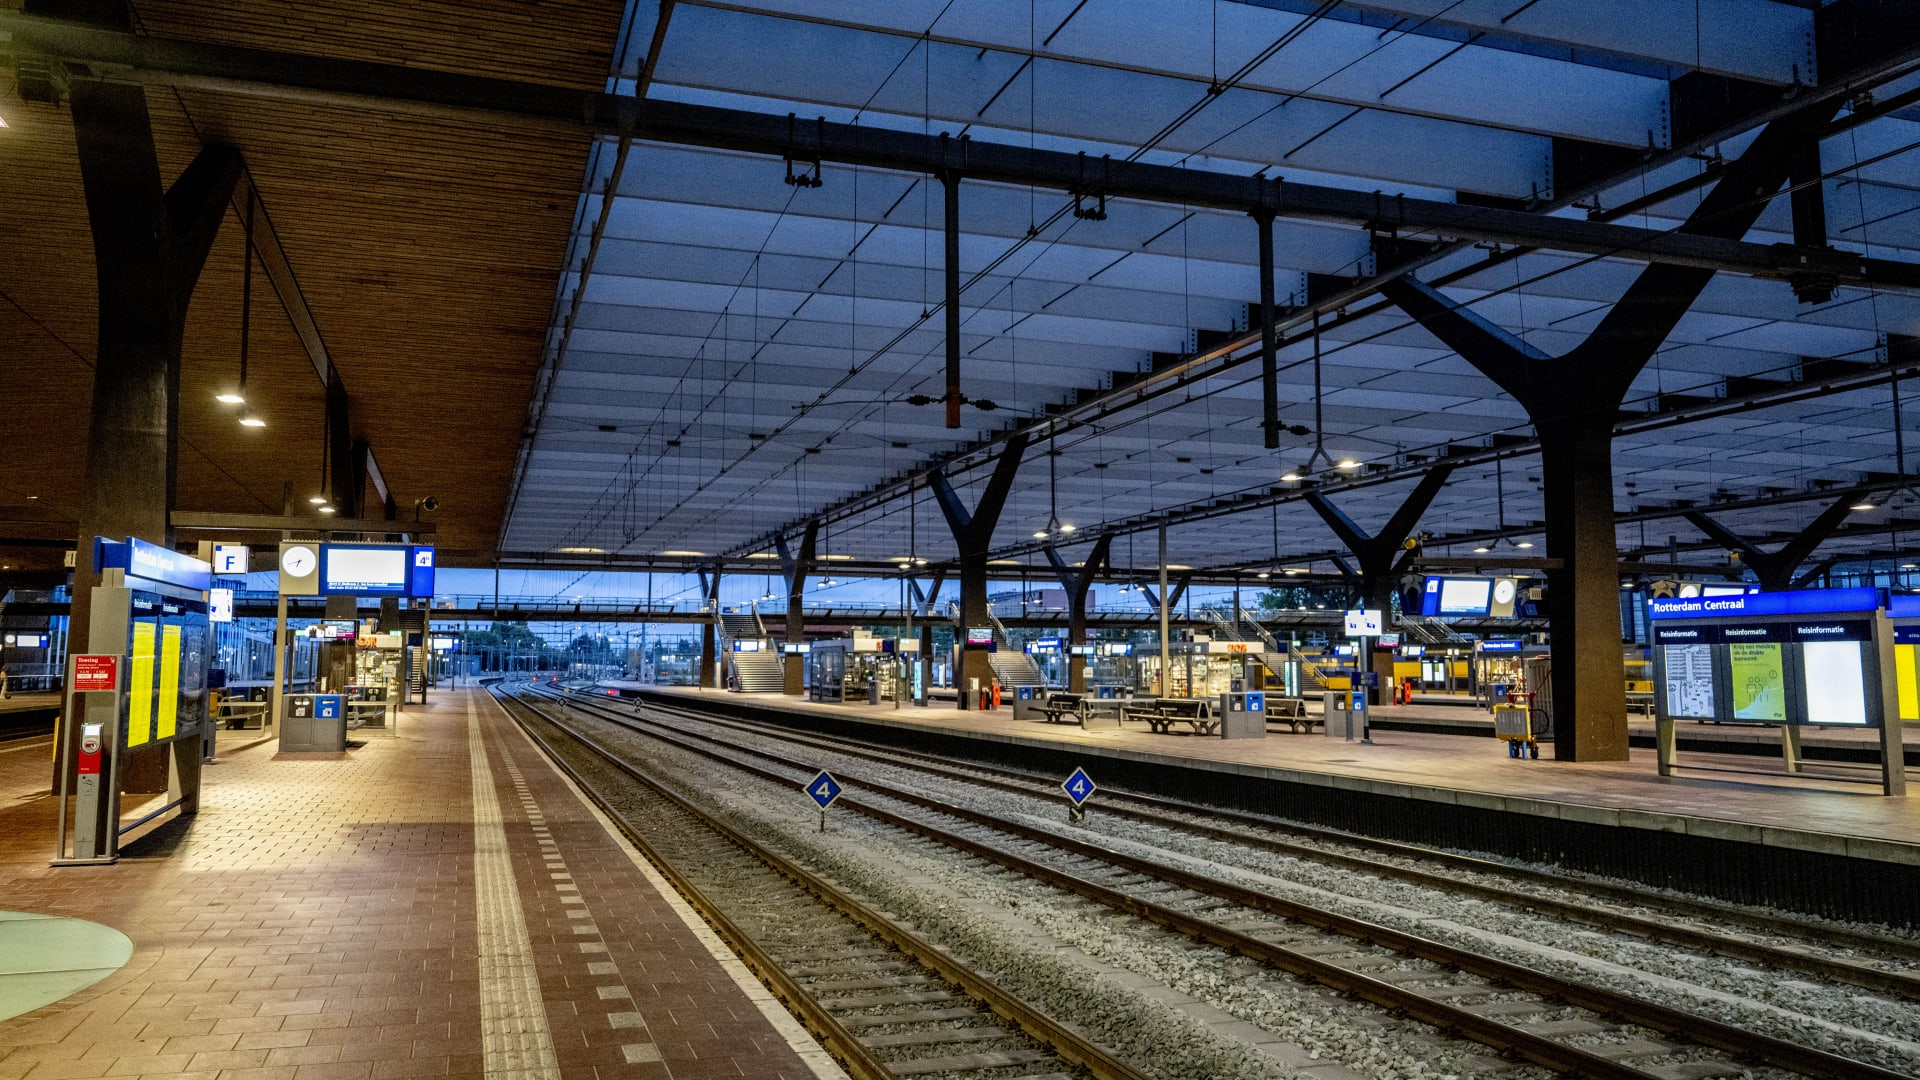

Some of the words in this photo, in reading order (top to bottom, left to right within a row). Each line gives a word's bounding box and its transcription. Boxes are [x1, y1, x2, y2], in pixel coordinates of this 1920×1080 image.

[225, 556, 235, 570] F
[1654, 601, 1701, 612] Rotterdam
[1704, 598, 1744, 609] Centraal
[1660, 630, 1698, 638] Reisinformatie
[1725, 628, 1767, 636] Reisinformatie
[1798, 625, 1844, 634] Reisinformatie
[815, 782, 830, 798] 4
[1071, 779, 1085, 795] 4
